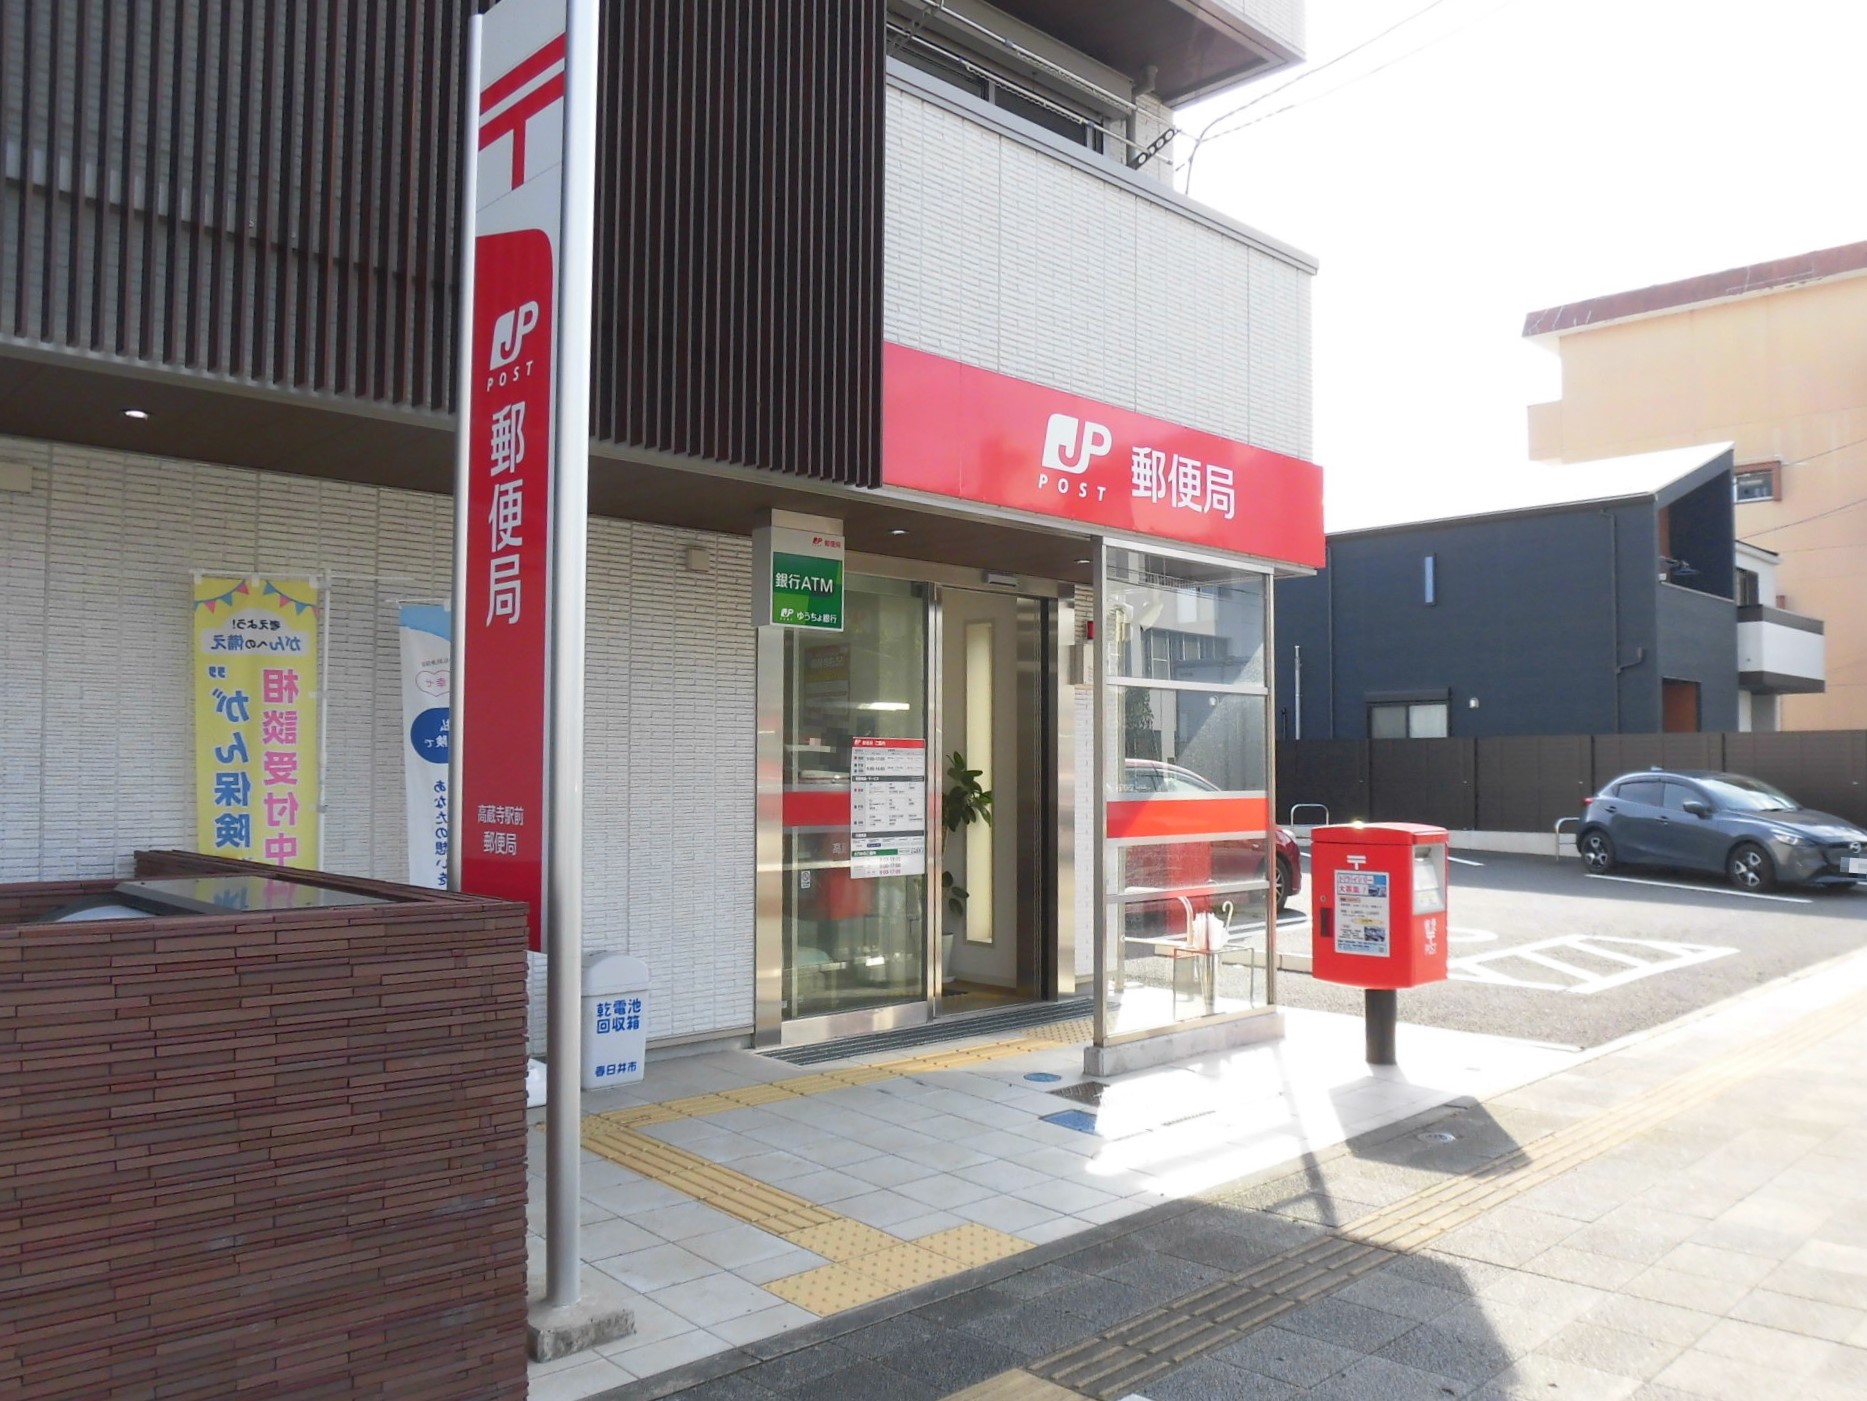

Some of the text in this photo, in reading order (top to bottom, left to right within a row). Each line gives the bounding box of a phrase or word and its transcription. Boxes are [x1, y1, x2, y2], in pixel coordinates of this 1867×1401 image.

[487, 360, 534, 392] POST
[1038, 474, 1107, 502] POST
[1131, 446, 1235, 520] 郵便局
[486, 400, 526, 627] 郵便局
[775, 572, 834, 593] 銀行ATM
[796, 611, 838, 624] ゆうちょ銀行
[477, 804, 524, 826] 高蔵寺駅前
[483, 831, 517, 855] 郵便局
[596, 998, 641, 1017] 乾電池
[596, 1015, 640, 1034] 回収箱
[595, 1061, 637, 1077] 春日井市
